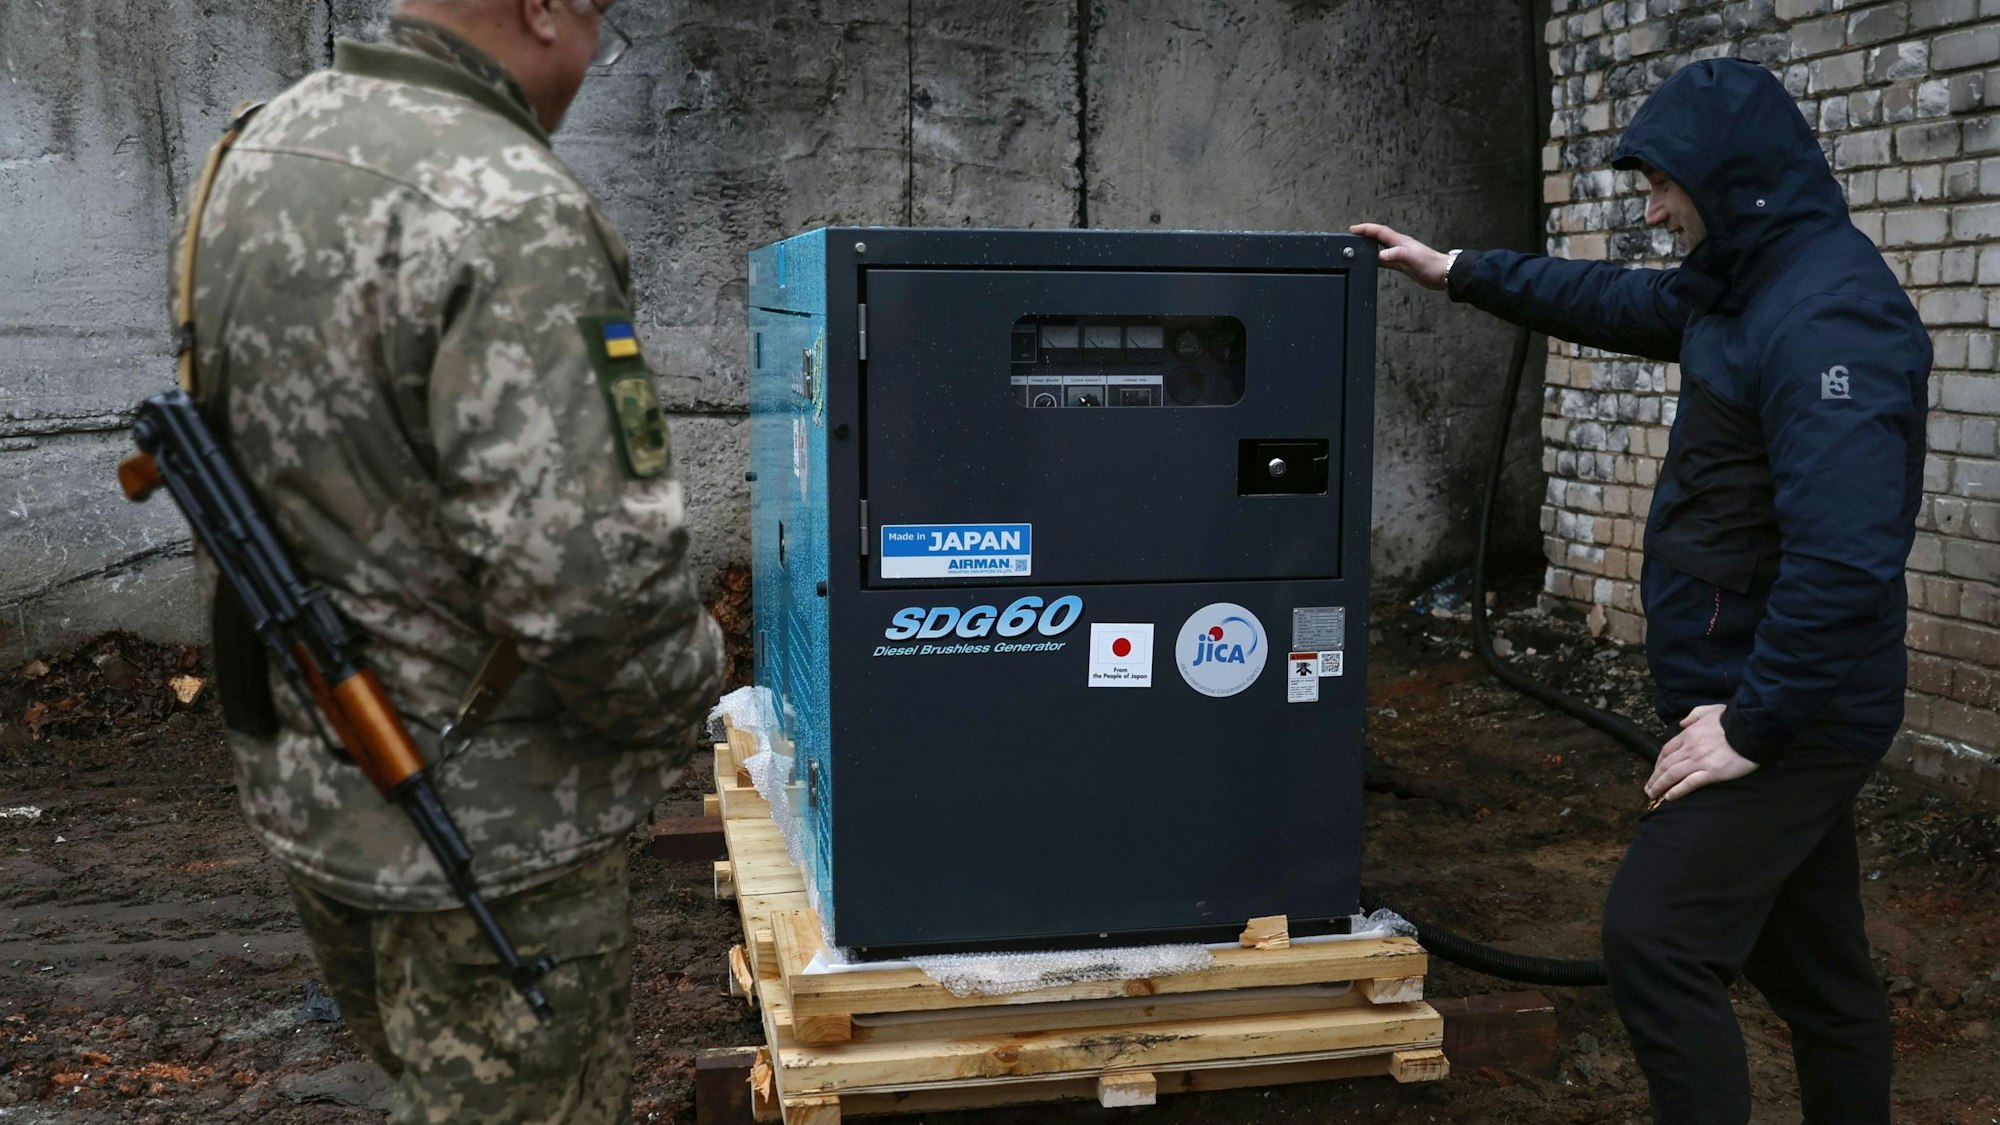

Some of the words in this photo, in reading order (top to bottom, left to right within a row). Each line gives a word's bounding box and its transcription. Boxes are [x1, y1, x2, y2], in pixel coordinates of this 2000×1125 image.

[888, 533, 914, 541] Made
[916, 532, 926, 541] in
[928, 531, 1021, 551] JAPAN
[948, 558, 1010, 569] AIRMAN
[884, 595, 1083, 640] SDG60
[873, 645, 917, 657] Diesel
[919, 643, 990, 655] Brushless
[993, 641, 1066, 653] Generator
